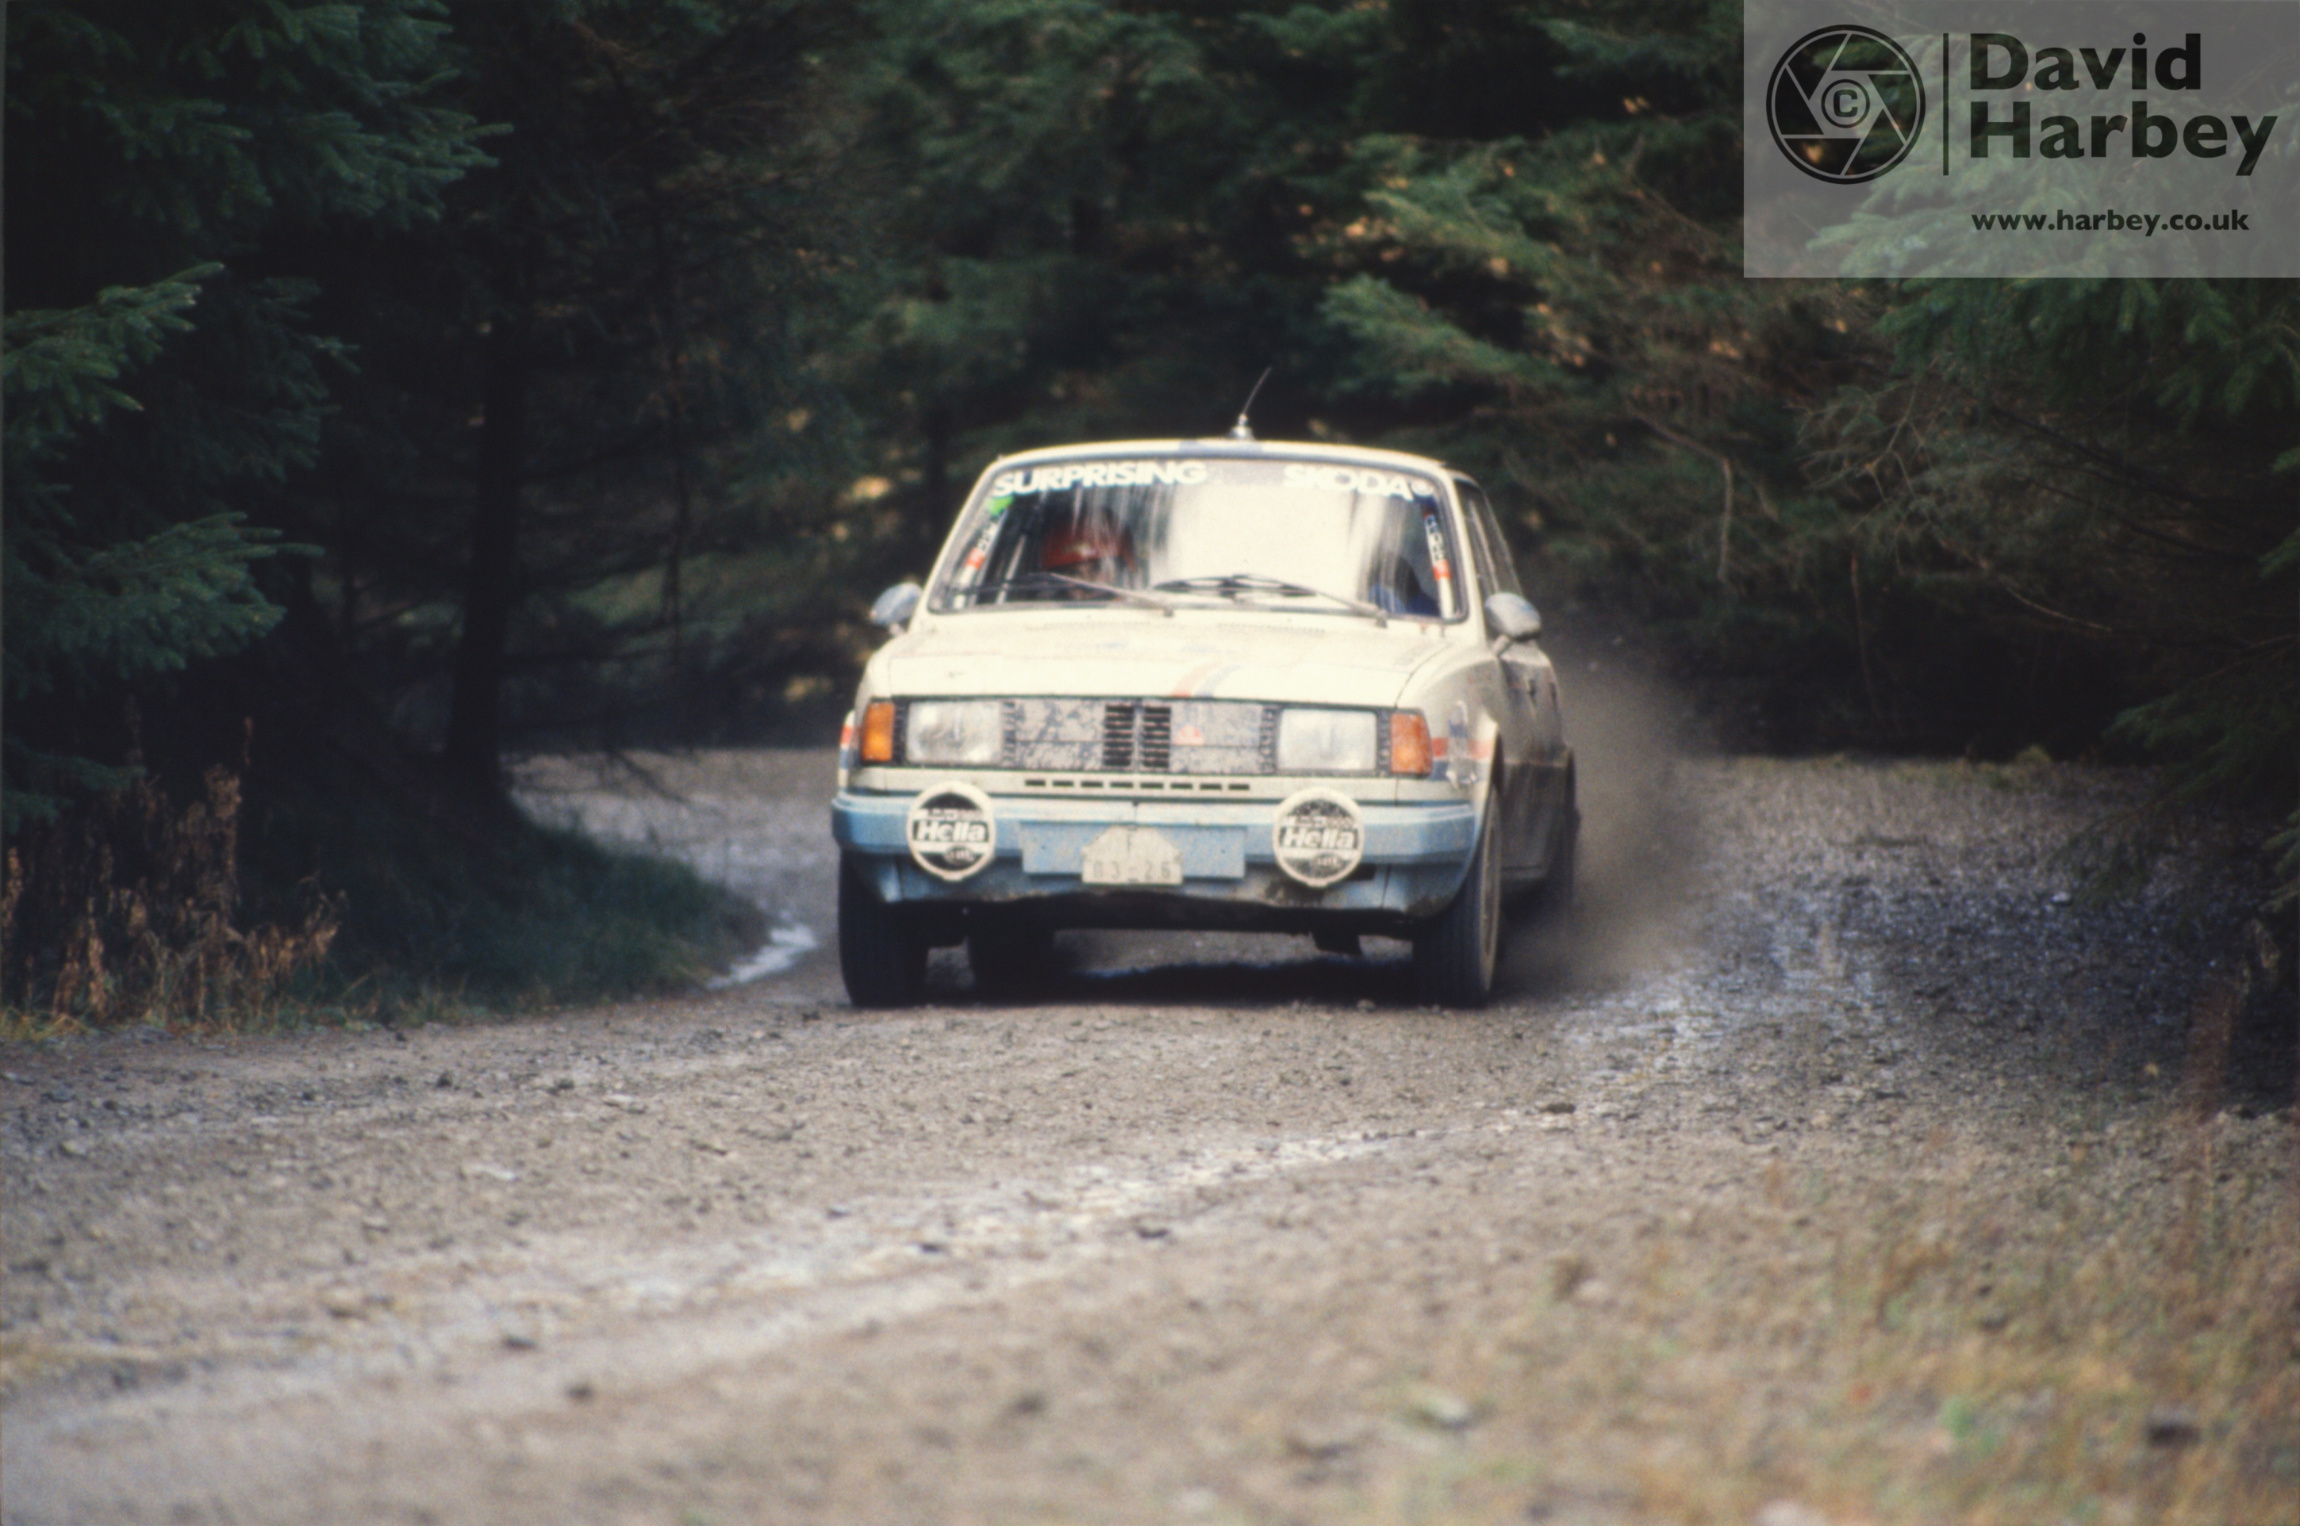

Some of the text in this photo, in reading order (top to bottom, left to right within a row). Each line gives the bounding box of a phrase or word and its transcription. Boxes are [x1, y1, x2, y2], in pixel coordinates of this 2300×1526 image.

[992, 459, 1208, 498] SURPRISING
[917, 819, 986, 841] Hella
[1283, 828, 1355, 849] Hella
